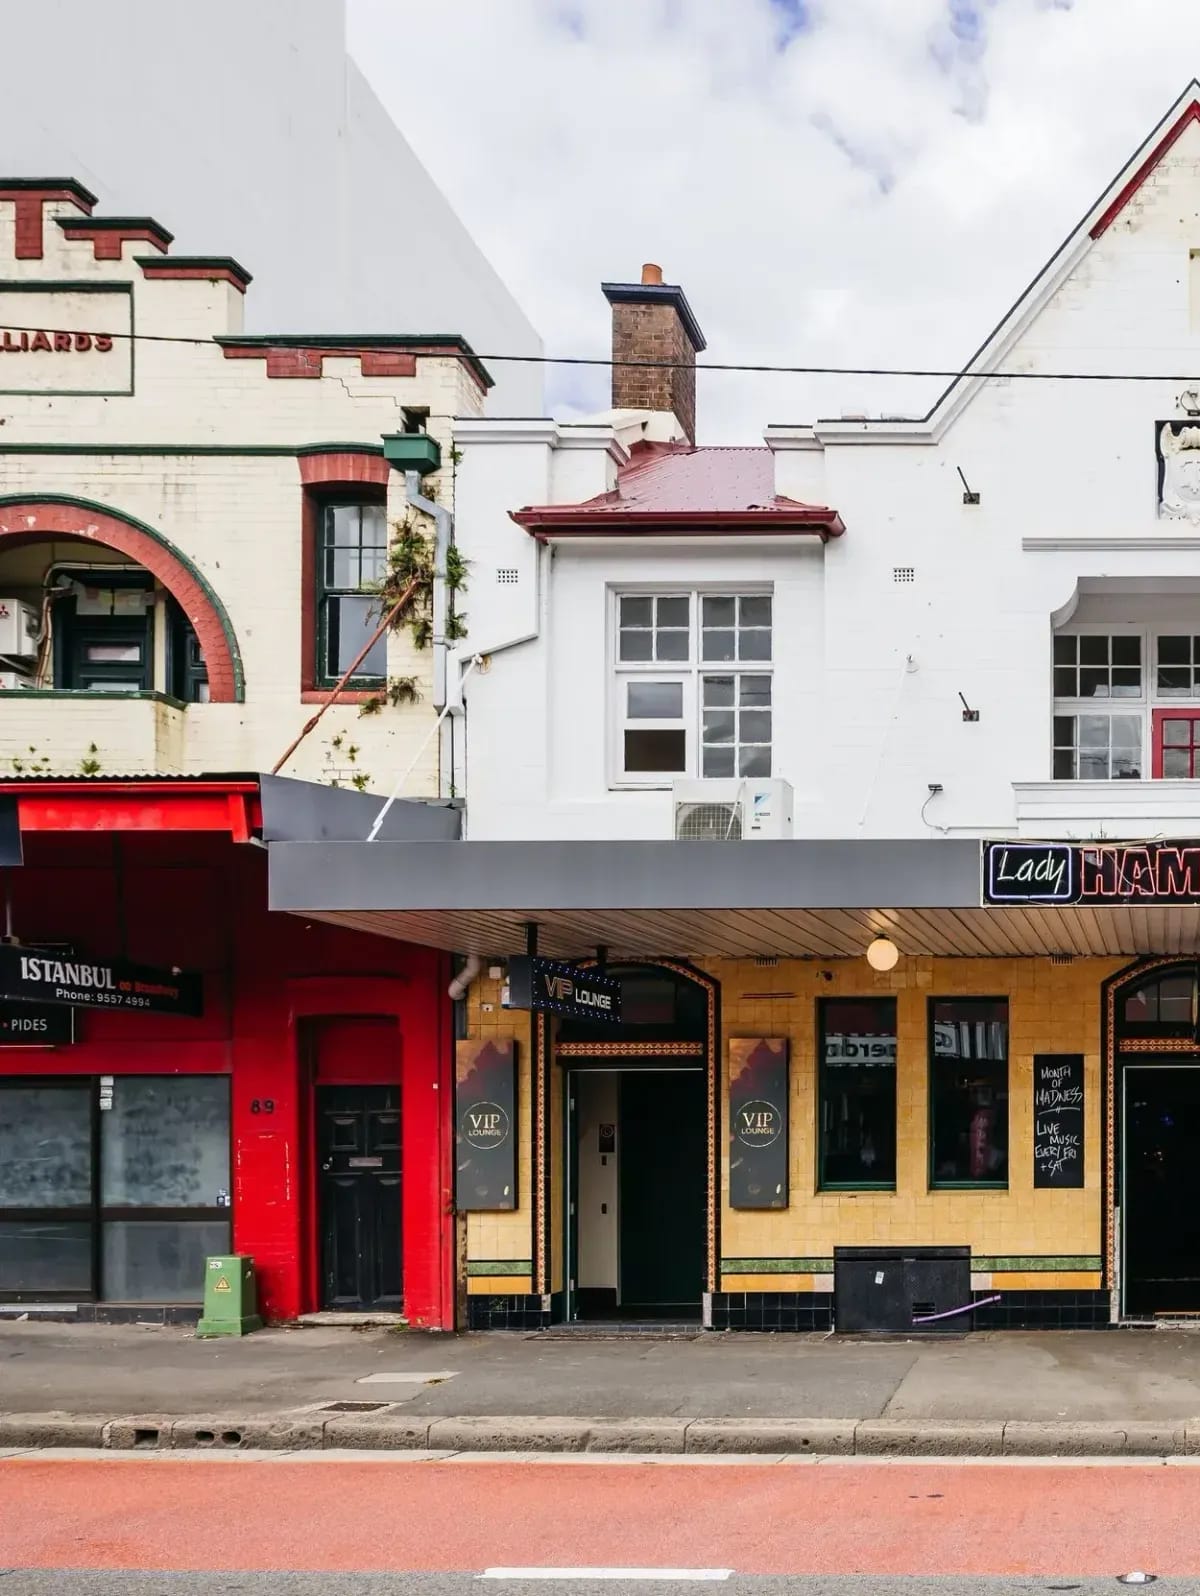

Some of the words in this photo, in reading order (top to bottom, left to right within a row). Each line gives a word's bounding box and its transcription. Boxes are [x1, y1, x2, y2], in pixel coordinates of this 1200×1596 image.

[0, 331, 113, 352] LIARDS
[997, 849, 1066, 893] Lady
[20, 956, 116, 990] ISTANBUL
[55, 987, 95, 1003] Phone:
[96, 992, 122, 1006] 9557
[125, 996, 151, 1008] 4994
[544, 974, 573, 1000] VIP
[575, 988, 612, 1010] LOUNGE
[11, 1017, 48, 1032] PIDES
[1041, 1065, 1071, 1080] MONTH
[1051, 1078, 1063, 1088] OF
[1036, 1086, 1083, 1107] MADNESS
[251, 1099, 275, 1115] 89
[469, 1113, 501, 1129] VIP
[741, 1112, 774, 1127] VIP
[468, 1129, 502, 1137] LOUNGE
[741, 1127, 775, 1135] LOUNGE
[1037, 1120, 1060, 1136] LIVE
[1049, 1133, 1080, 1146] MUSIC
[1035, 1144, 1060, 1159] EVERY
